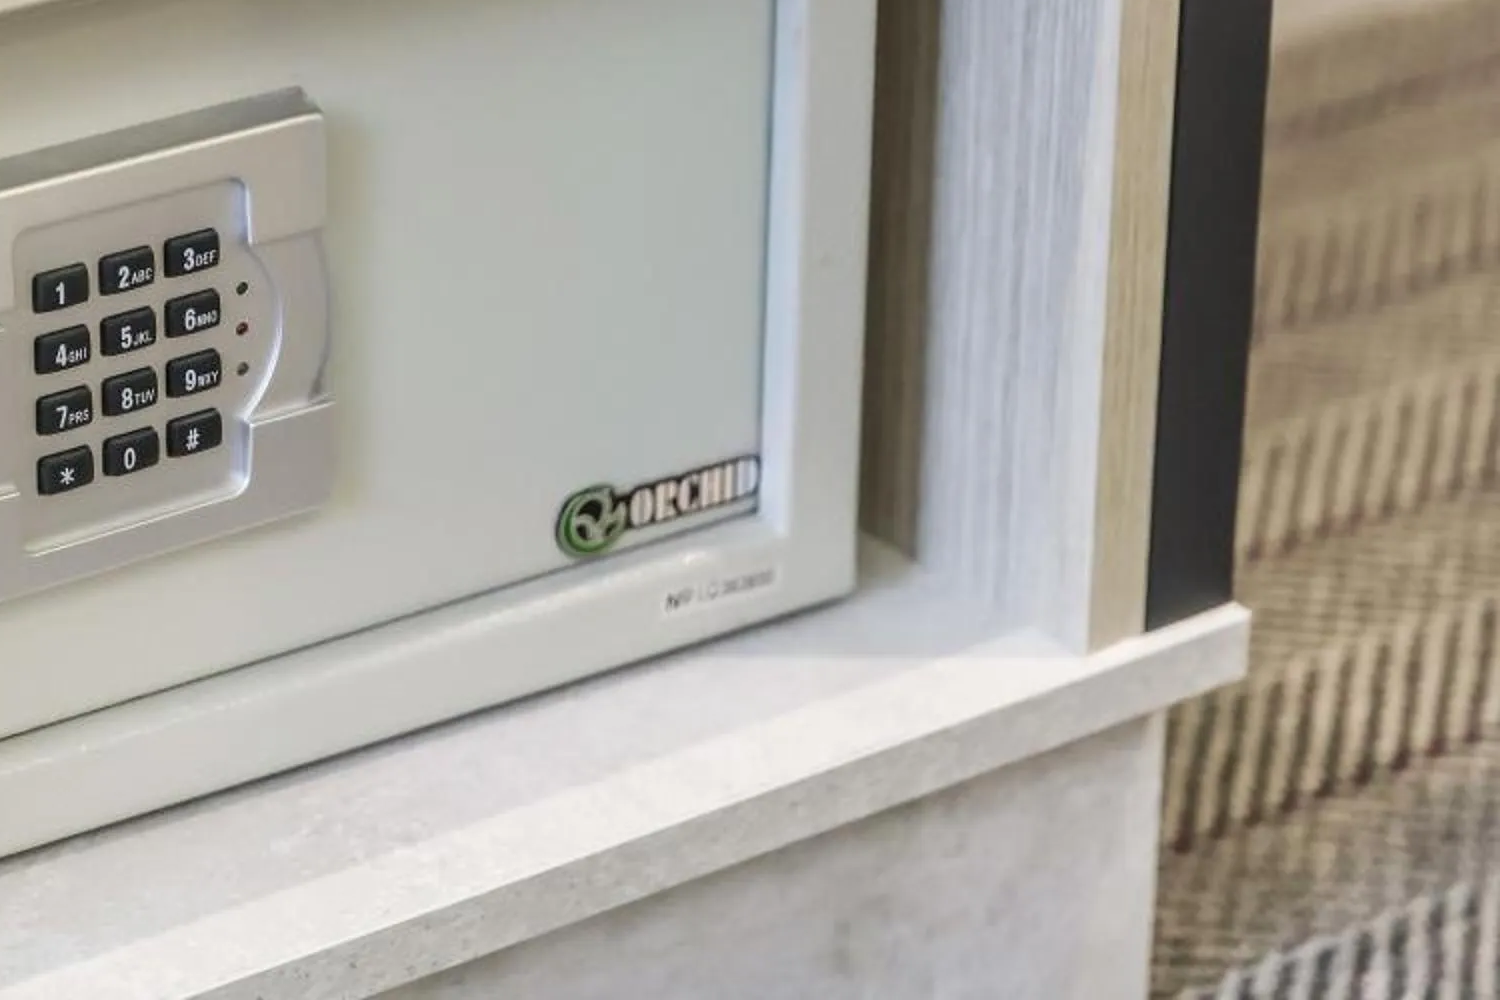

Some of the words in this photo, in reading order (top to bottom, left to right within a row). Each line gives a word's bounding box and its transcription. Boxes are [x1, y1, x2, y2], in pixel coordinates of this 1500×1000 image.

[55, 282, 65, 305] 1
[124, 447, 136, 470] 0
[629, 458, 760, 527] ORCHID
